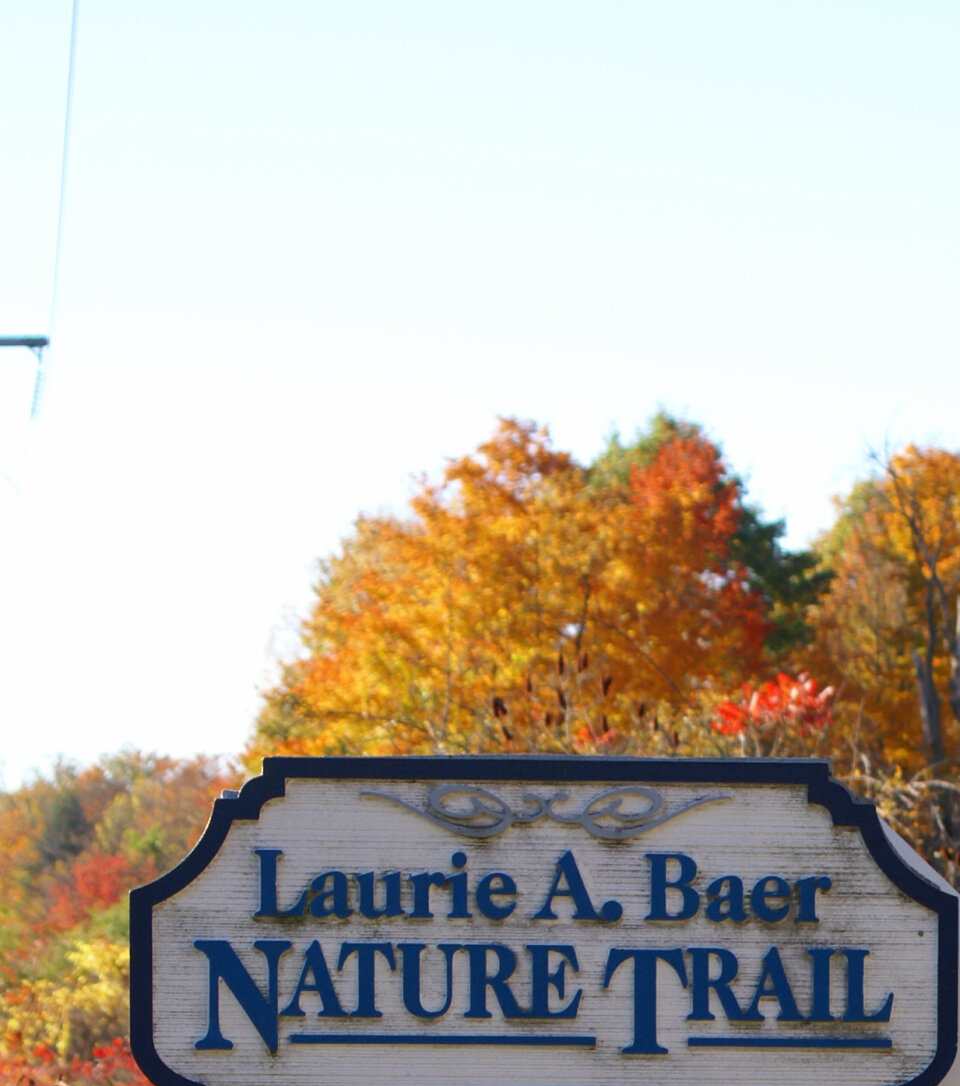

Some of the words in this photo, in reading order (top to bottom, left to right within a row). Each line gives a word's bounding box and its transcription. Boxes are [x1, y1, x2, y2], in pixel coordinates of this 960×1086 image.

[253, 849, 517, 921] Laurie
[532, 849, 623, 924] A.
[645, 852, 833, 925] Baer
[193, 939, 585, 1055] NATURE
[603, 945, 895, 1055] TRAIL
